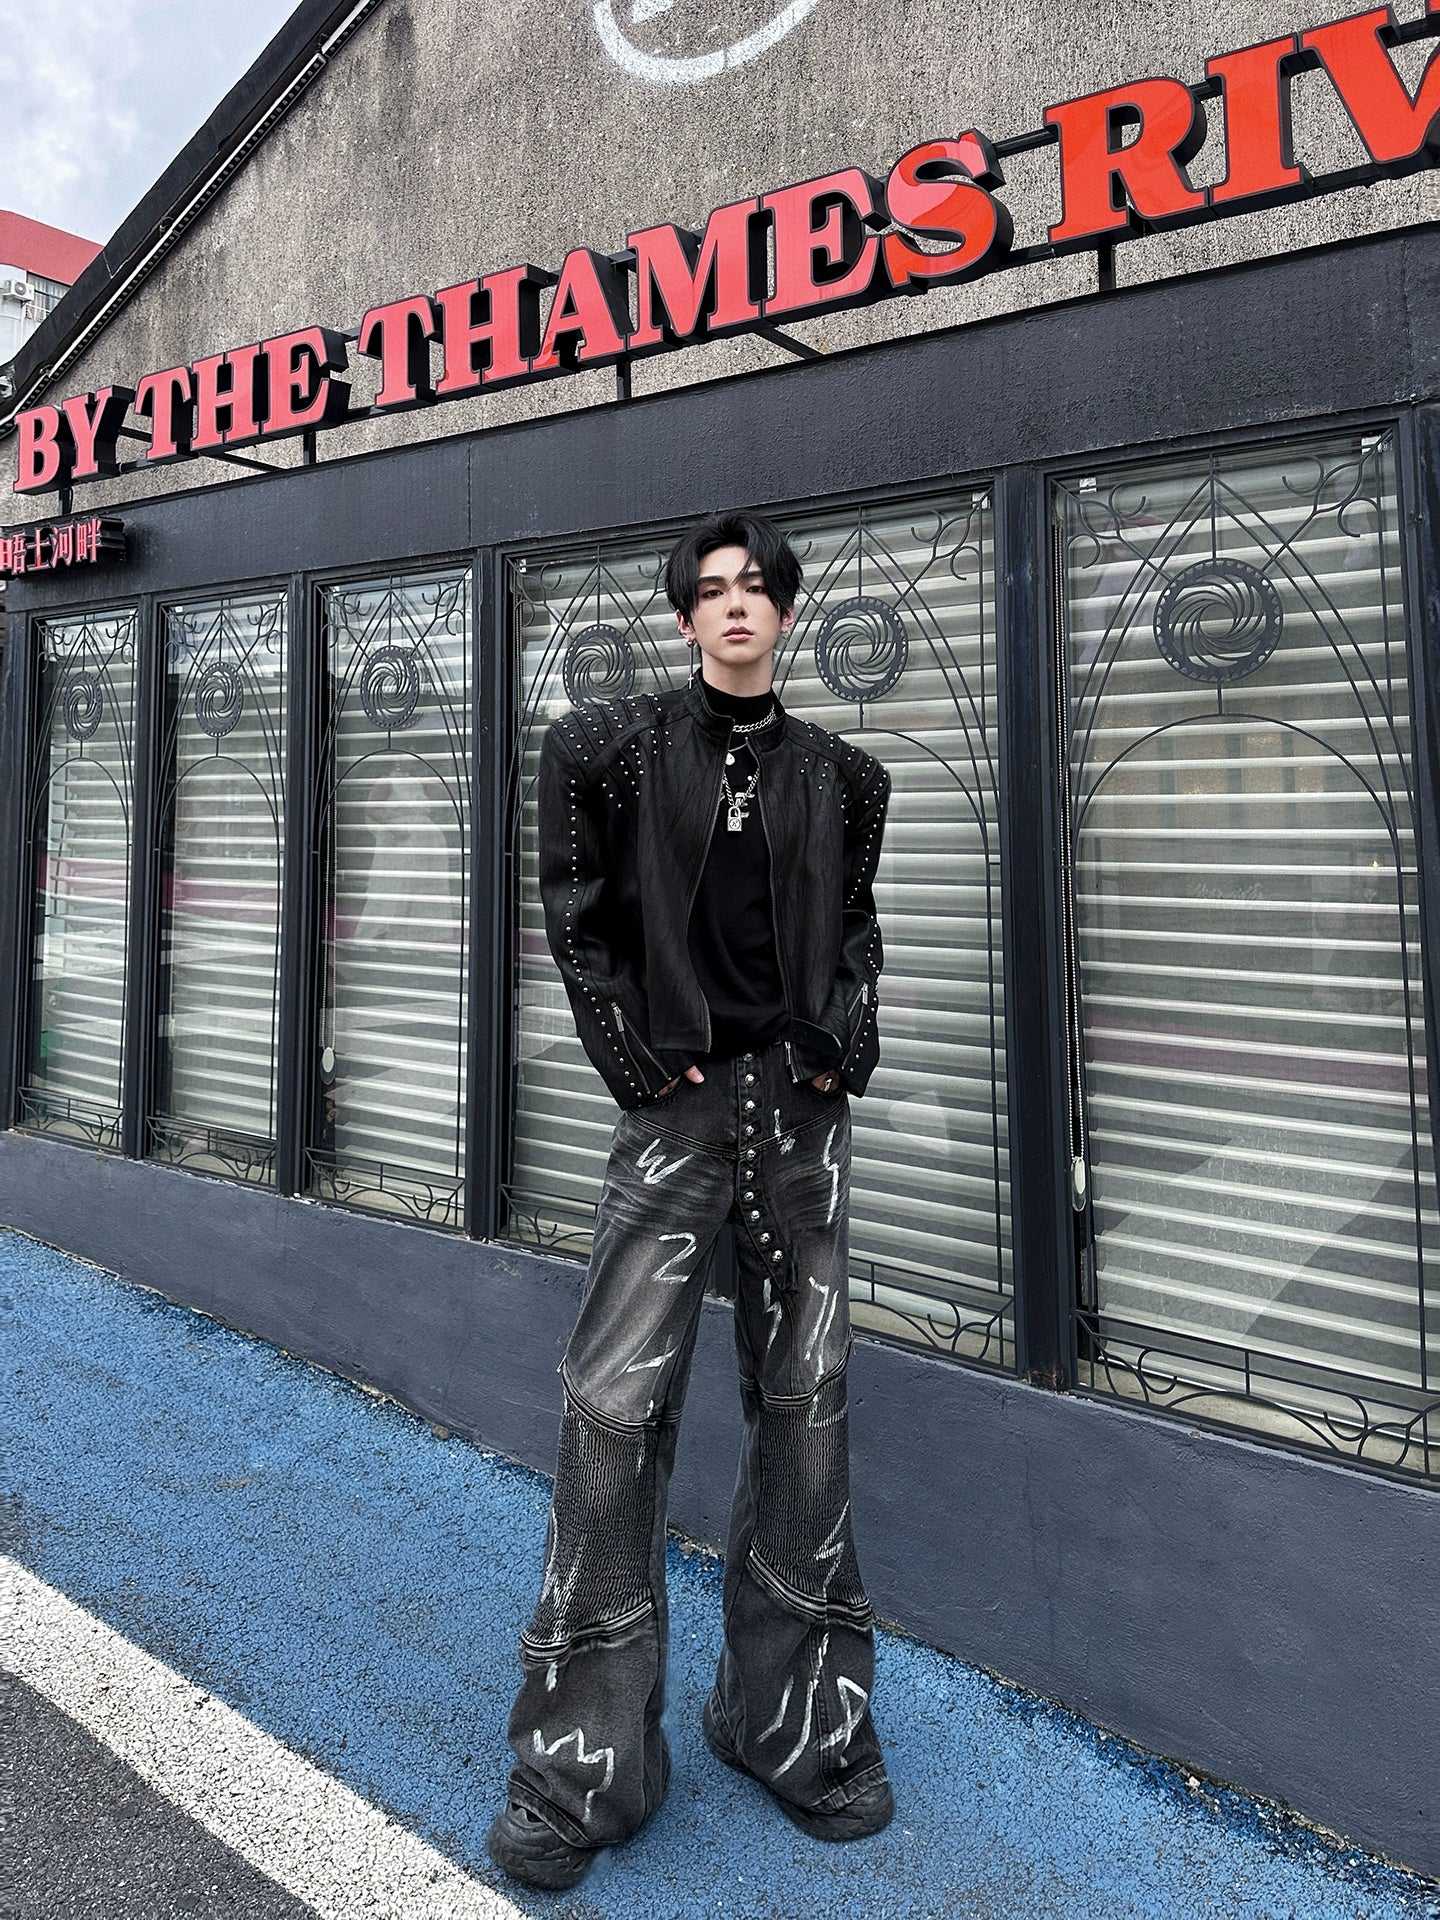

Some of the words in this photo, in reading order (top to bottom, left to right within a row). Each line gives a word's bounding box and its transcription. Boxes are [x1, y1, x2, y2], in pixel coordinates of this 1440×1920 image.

[13, 386, 116, 494] BY
[134, 326, 332, 460] THE
[358, 130, 997, 409] THAMES
[1044, 0, 1440, 244] RIV
